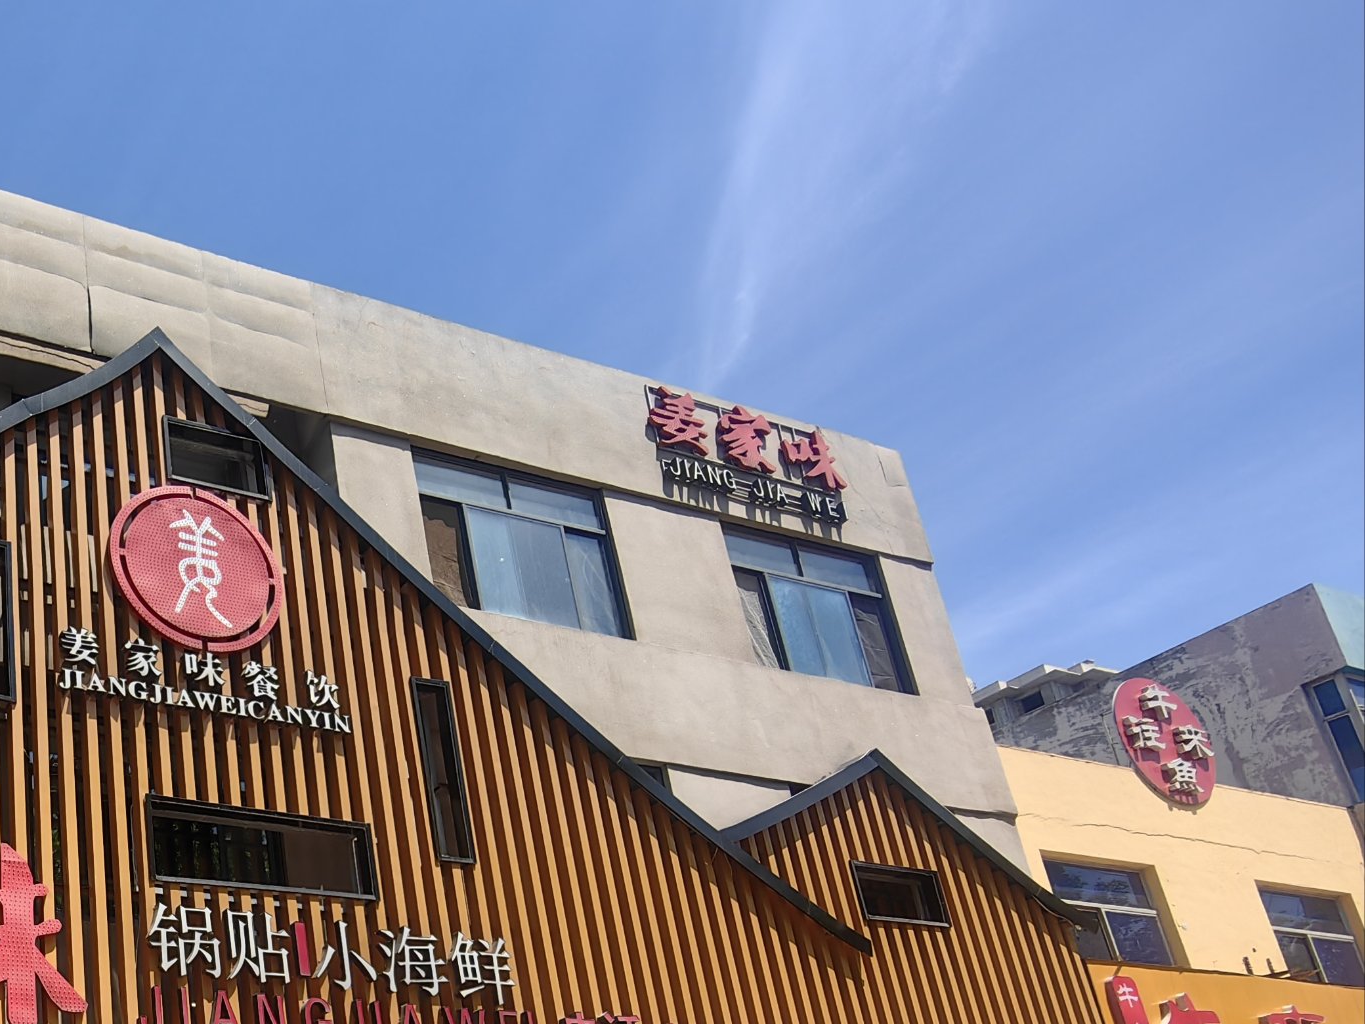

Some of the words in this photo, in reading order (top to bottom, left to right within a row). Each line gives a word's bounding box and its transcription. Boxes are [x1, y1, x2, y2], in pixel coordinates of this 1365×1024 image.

[648, 385, 848, 491] 姜家味
[669, 456, 737, 490] JIANG
[751, 478, 789, 504] JIA
[807, 491, 850, 521] WEI
[59, 626, 341, 710] 姜家味餐饮
[59, 667, 352, 734] JIANGJIAWEICANYIN
[147, 900, 292, 984] 锅贴
[317, 918, 518, 1006] 小海鲜
